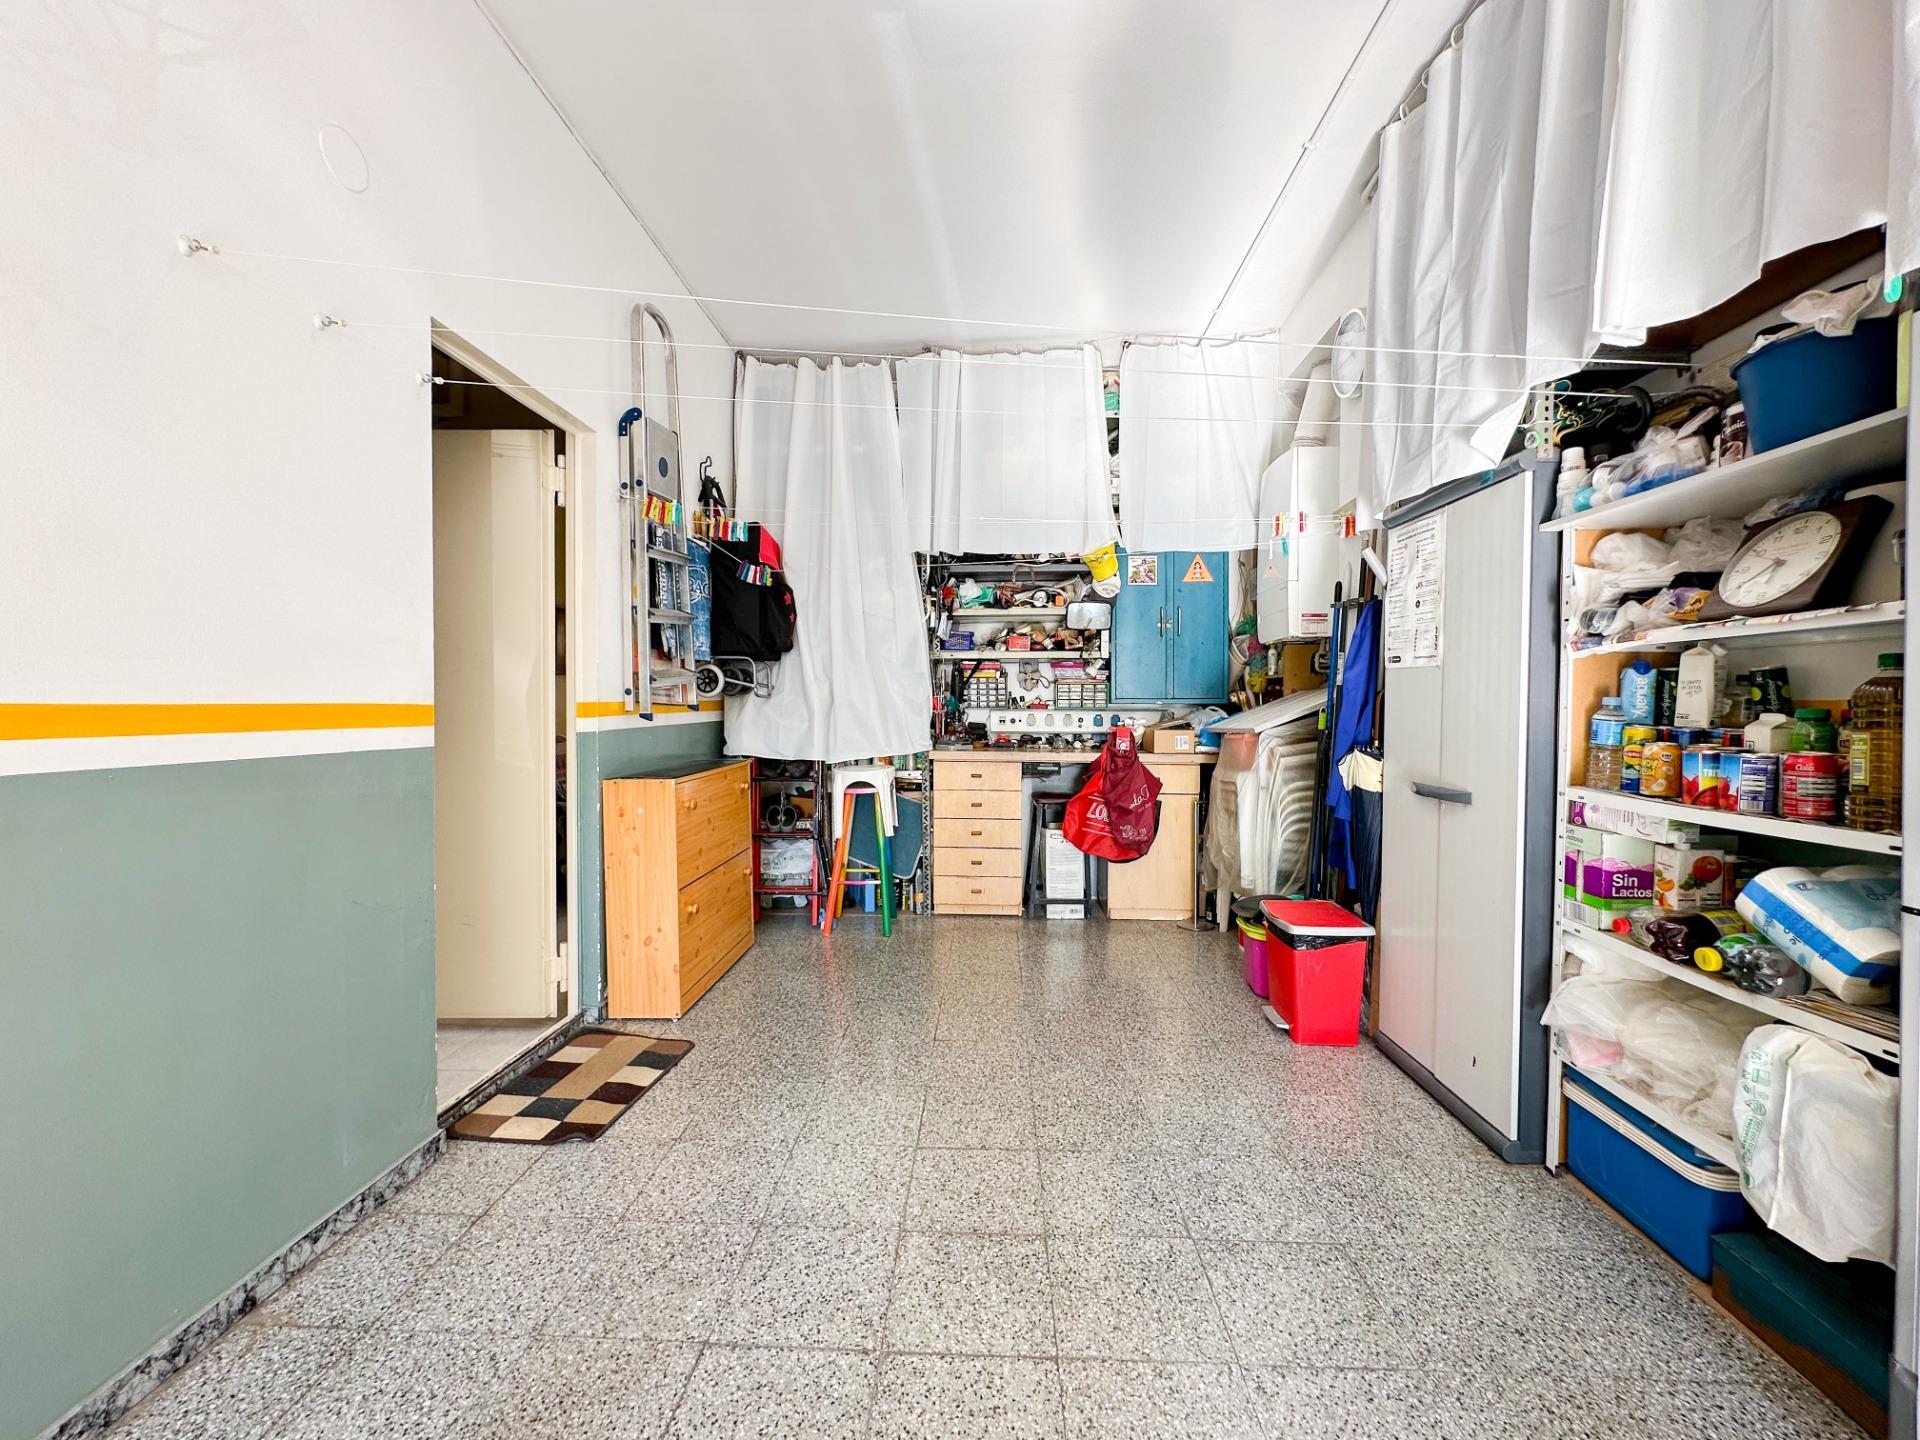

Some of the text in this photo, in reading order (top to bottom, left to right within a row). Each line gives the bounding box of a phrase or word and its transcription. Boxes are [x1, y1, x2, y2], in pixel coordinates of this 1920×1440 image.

[1795, 763, 1815, 771] Cola
[1612, 873, 1638, 887] Sin
[1611, 887, 1653, 897] Lactos
